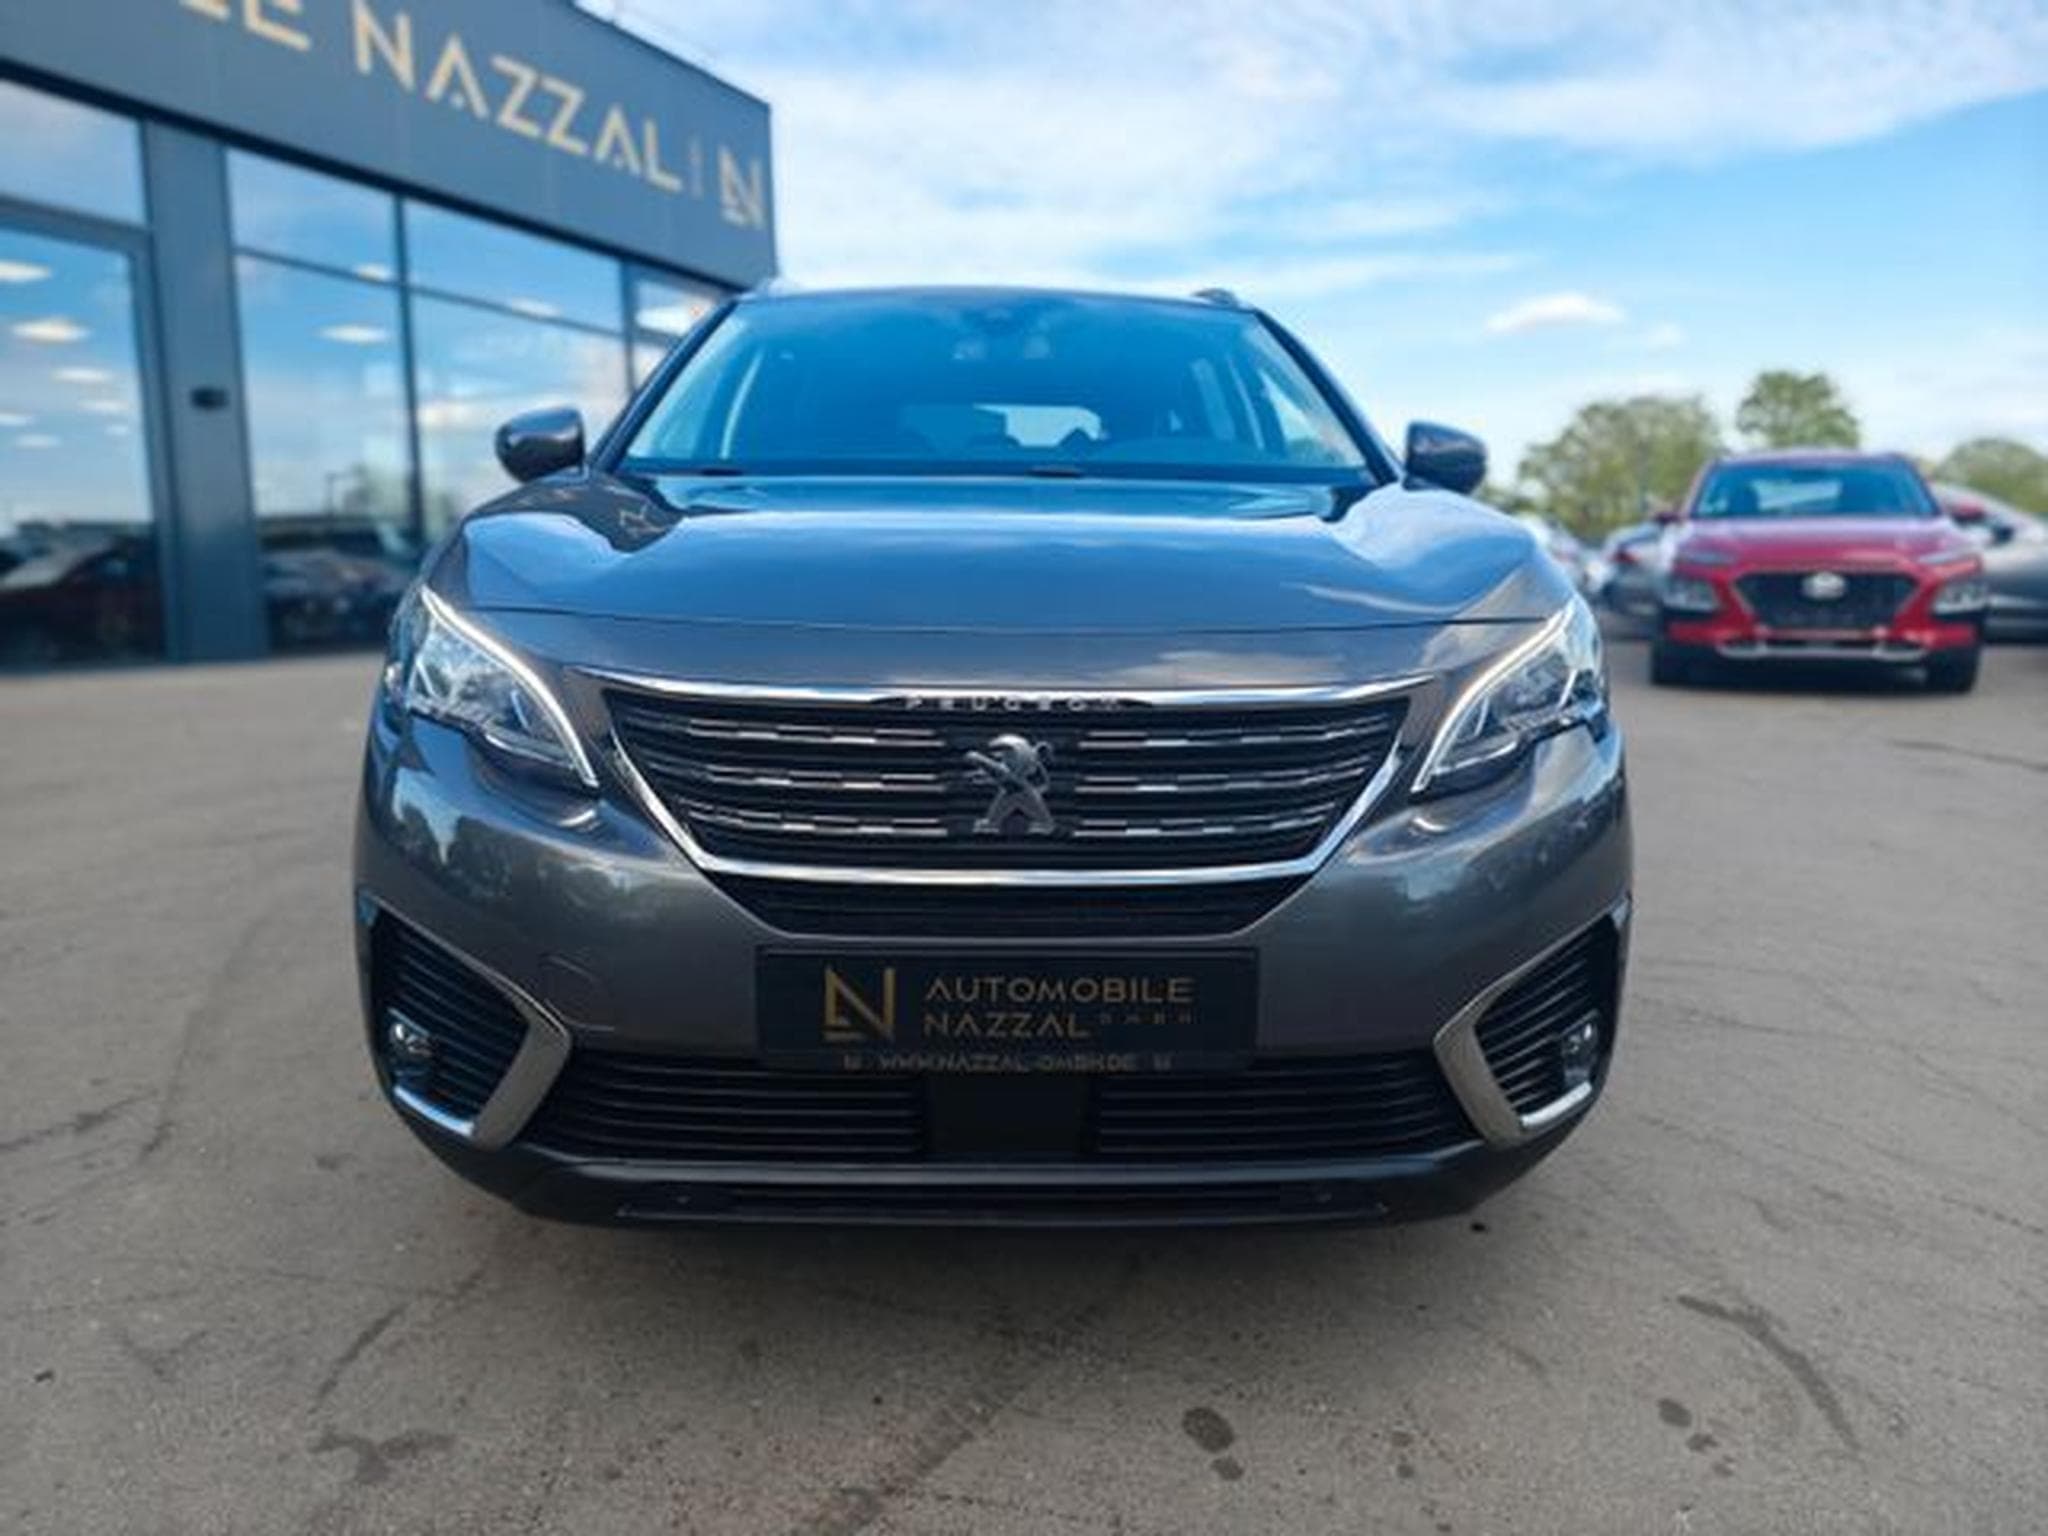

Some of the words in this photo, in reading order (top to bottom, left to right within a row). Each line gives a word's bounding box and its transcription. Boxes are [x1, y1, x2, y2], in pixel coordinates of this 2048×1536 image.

[352, 0, 683, 192] NAZZAL
[925, 976, 1196, 1003] AUTOMOBILE
[923, 1011, 1093, 1039] NAZZAL
